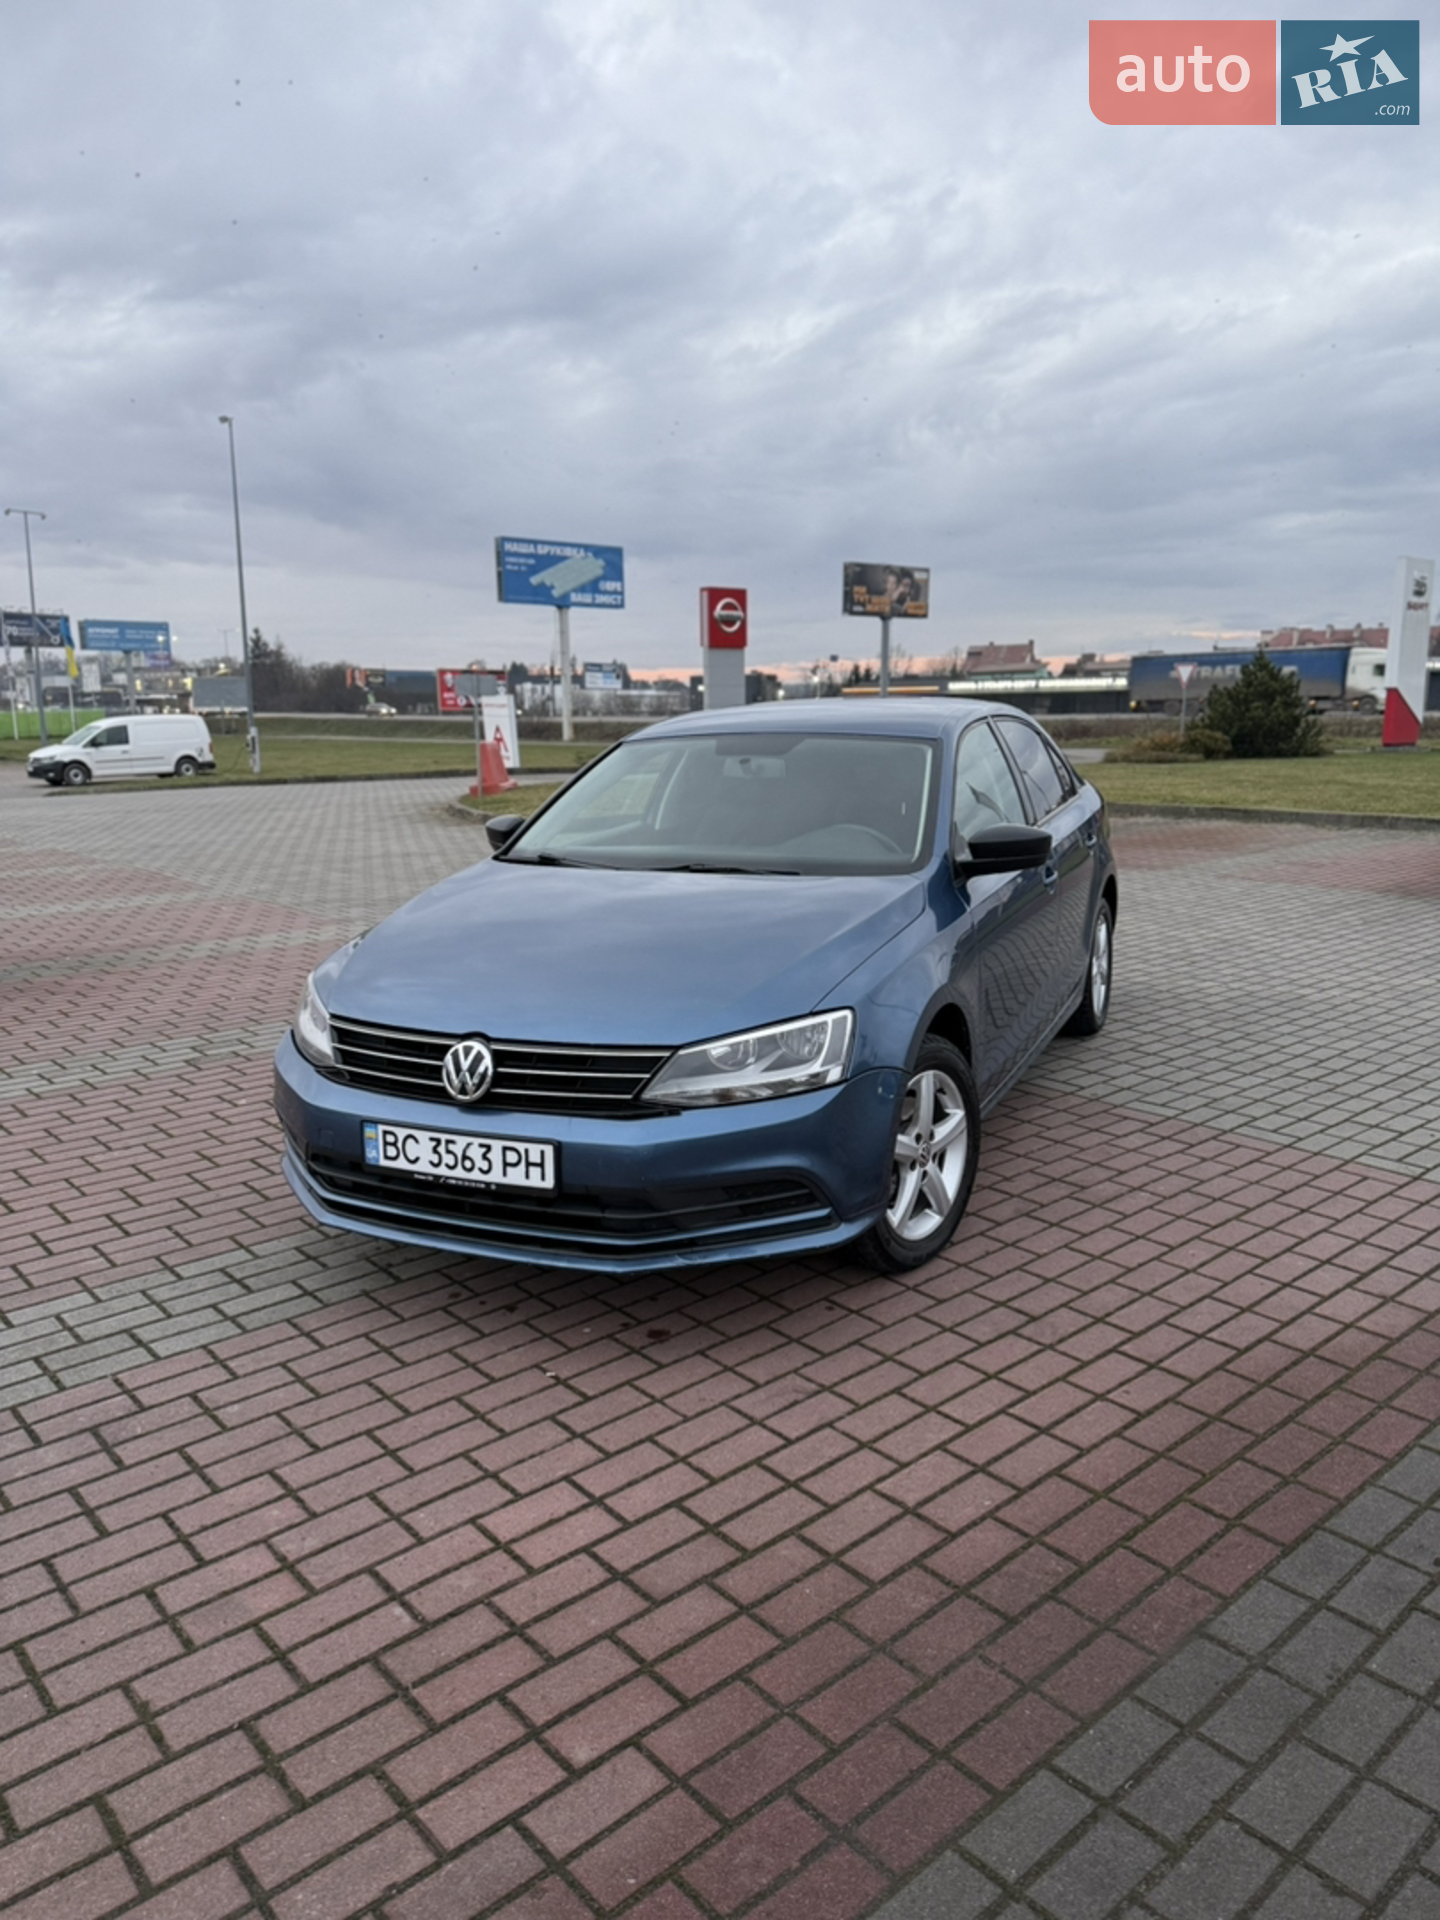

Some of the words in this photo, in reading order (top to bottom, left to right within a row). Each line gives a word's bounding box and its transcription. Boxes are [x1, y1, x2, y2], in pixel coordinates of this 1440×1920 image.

[382, 1130, 420, 1164] BC
[428, 1137, 493, 1175] 3563
[501, 1146, 546, 1181] PH
